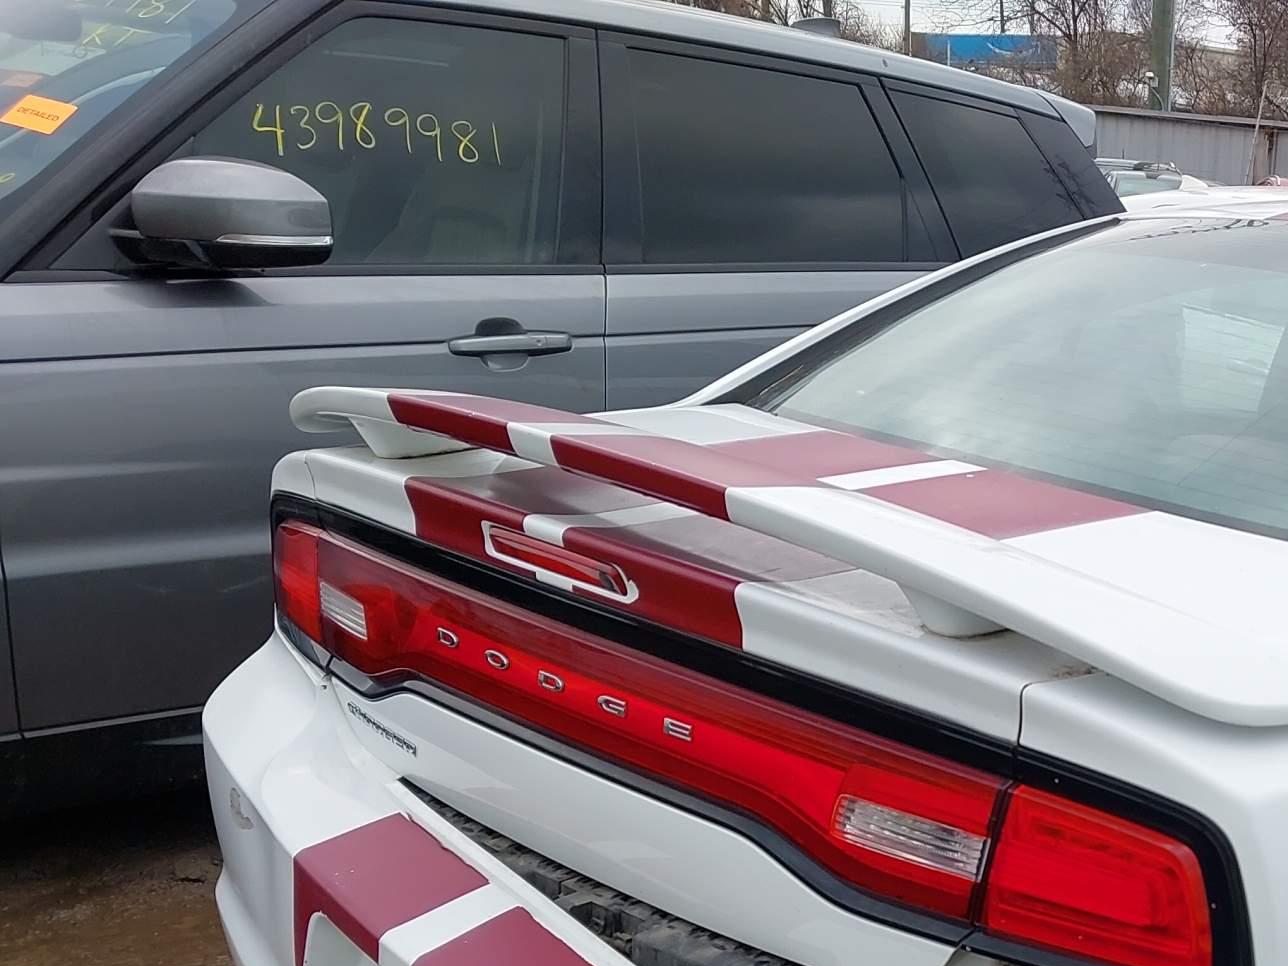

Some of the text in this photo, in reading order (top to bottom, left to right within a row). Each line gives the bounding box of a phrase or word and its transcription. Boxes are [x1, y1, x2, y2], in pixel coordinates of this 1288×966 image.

[16, 106, 60, 122] DETAILED
[252, 101, 502, 167] 43989981
[437, 626, 693, 742] DODGE
